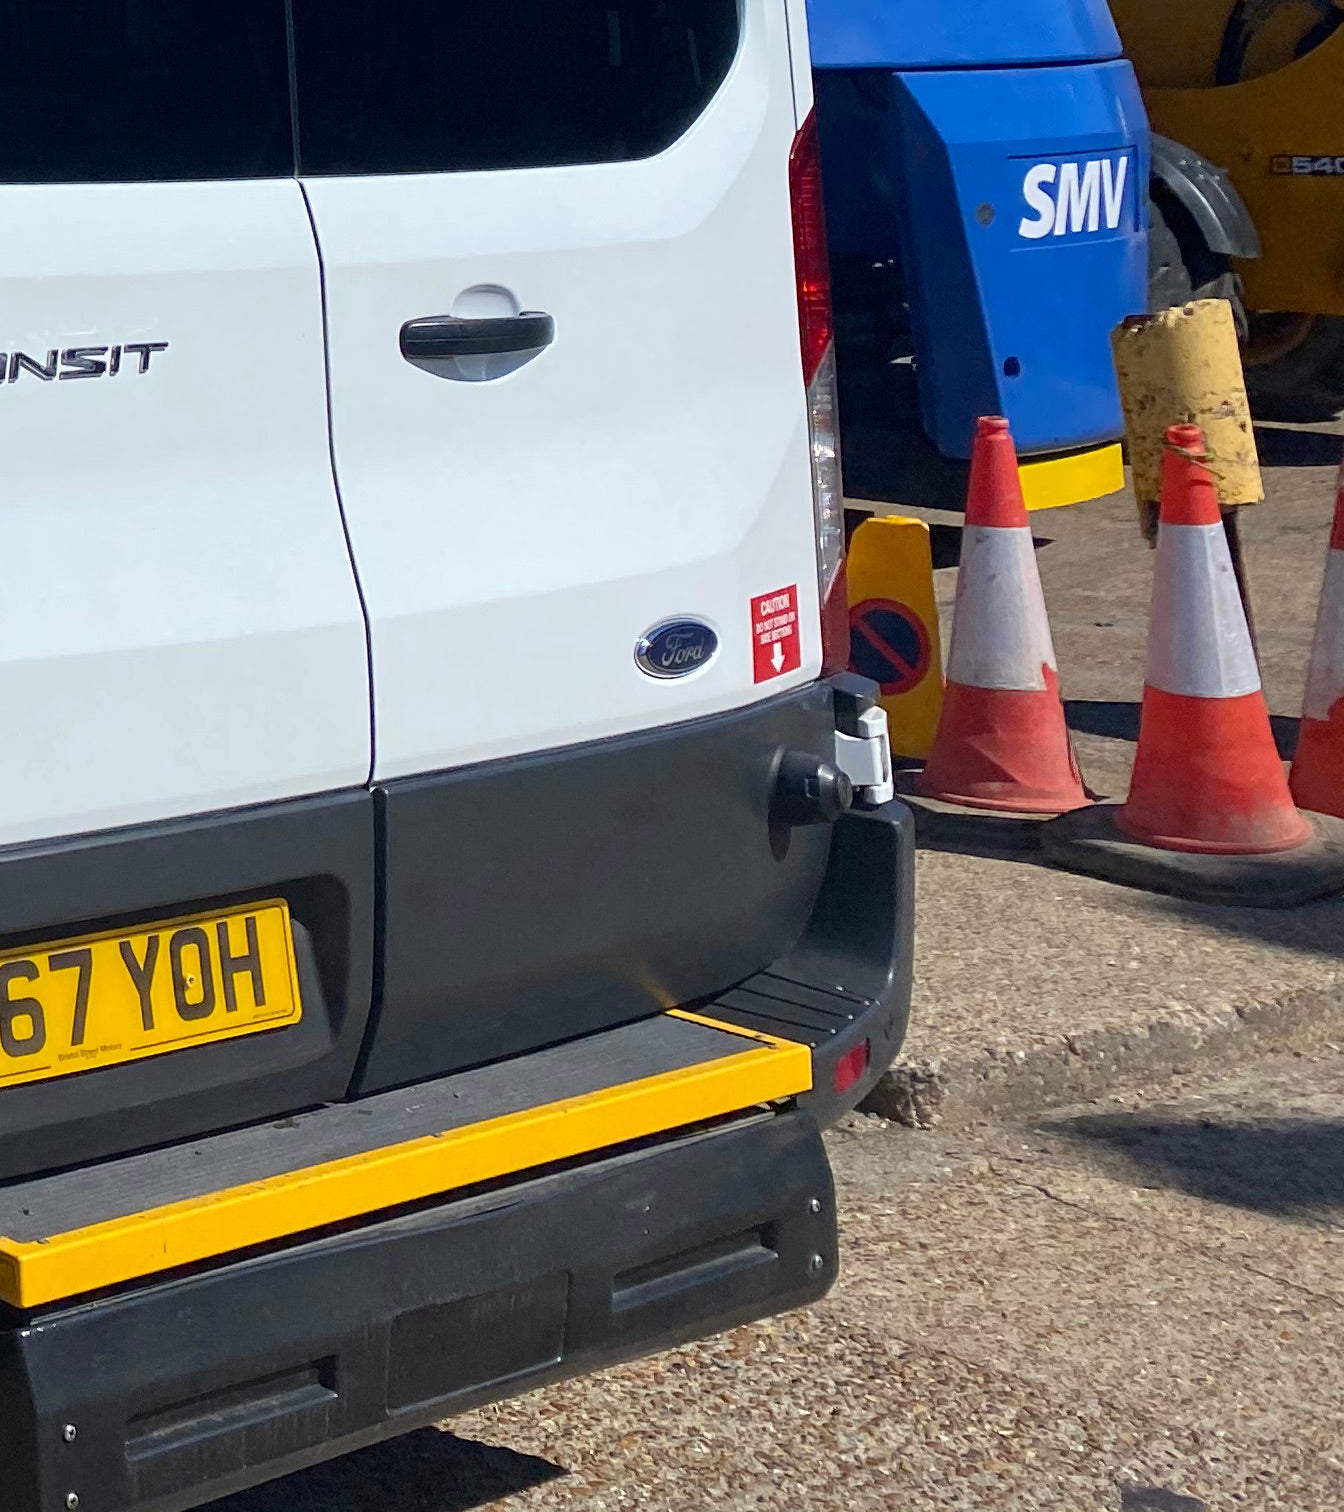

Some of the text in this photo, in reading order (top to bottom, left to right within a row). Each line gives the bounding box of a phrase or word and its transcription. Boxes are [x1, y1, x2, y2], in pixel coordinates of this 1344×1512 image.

[1018, 156, 1128, 239] SMV
[760, 593, 790, 617] CAUTION
[662, 631, 705, 667] Ford
[118, 915, 267, 1032] YOH
